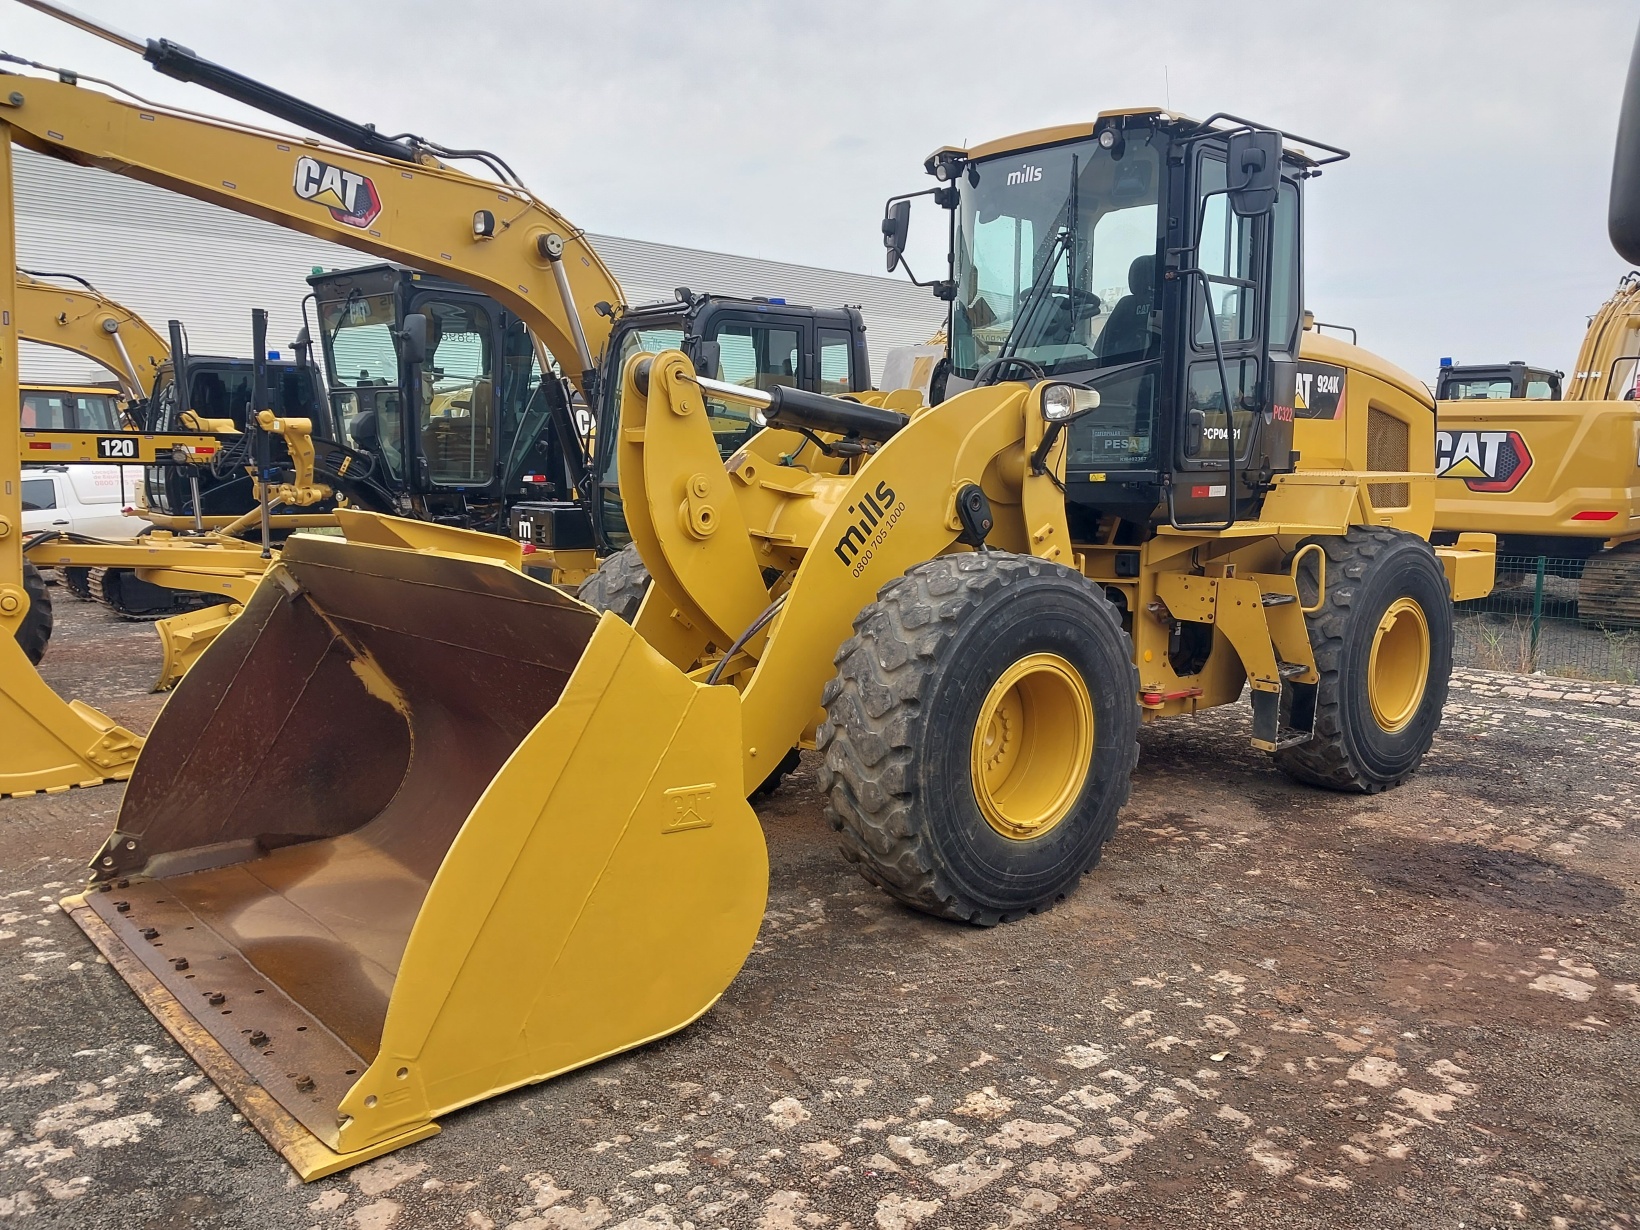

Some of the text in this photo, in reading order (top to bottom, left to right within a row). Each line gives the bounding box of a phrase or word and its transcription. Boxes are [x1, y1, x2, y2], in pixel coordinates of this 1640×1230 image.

[296, 157, 364, 213] CAT
[1007, 164, 1043, 186] mills
[1136, 303, 1150, 315] CAT
[1295, 372, 1340, 409] AT 924K
[1273, 404, 1293, 422] PC322
[1104, 439, 1139, 449] PESA
[1203, 427, 1241, 440] PCP0491
[101, 439, 134, 457] 120
[1436, 432, 1507, 478] CAT
[834, 480, 896, 567] mills
[852, 501, 906, 578] 0800 705 1000
